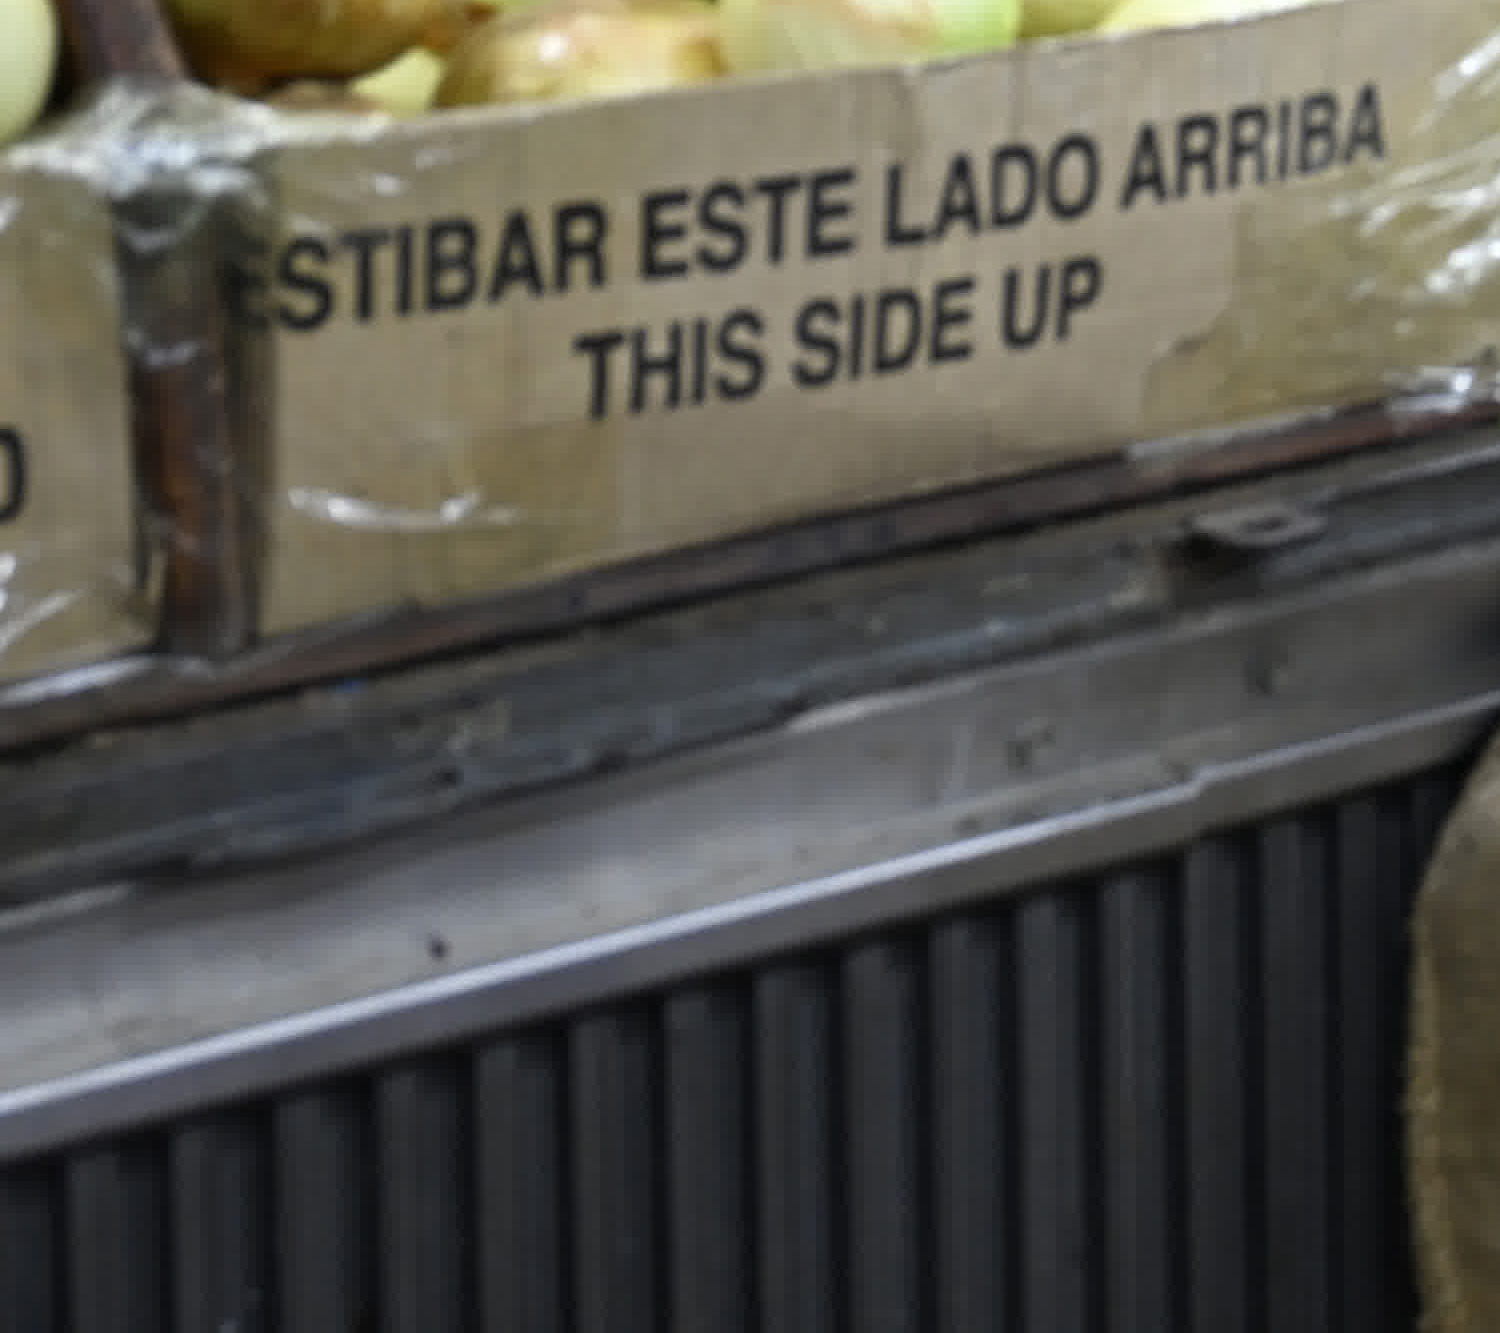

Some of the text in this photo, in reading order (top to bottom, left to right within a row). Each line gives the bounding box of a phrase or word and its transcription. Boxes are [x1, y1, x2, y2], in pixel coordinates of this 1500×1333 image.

[637, 165, 857, 282] ESTE
[883, 133, 1101, 250] LADO
[1119, 83, 1388, 209] ARRIBA
[573, 255, 1106, 421] THIS SIDE UP
